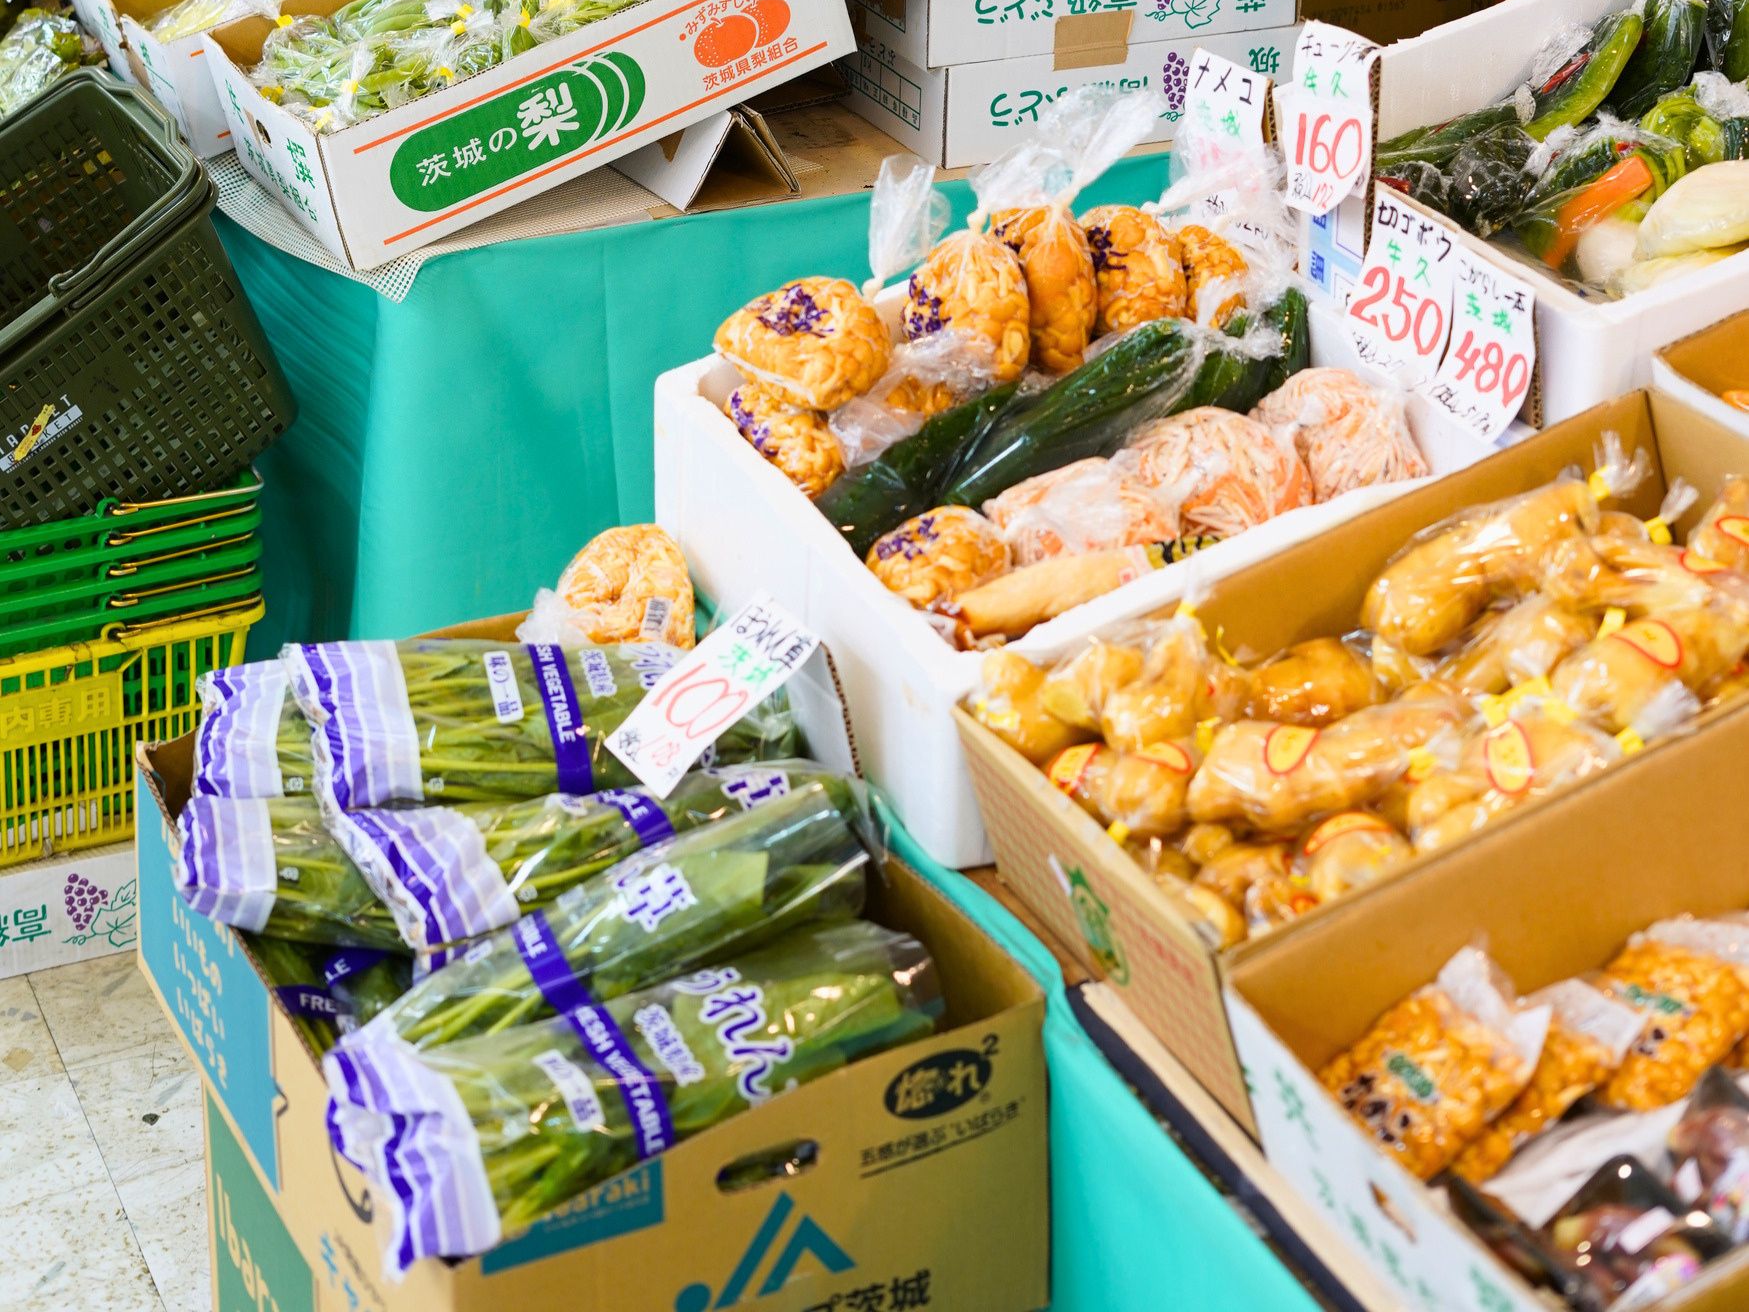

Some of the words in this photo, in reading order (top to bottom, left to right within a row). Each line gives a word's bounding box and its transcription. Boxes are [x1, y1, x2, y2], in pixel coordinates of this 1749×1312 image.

[702, 36, 799, 92] 茨城県梨組合
[1194, 57, 1252, 105] ナメコ
[416, 82, 580, 187] 茨城の梨
[1295, 112, 1363, 180] 160
[1350, 266, 1443, 356] 250
[1454, 330, 1528, 409] 480
[541, 663, 577, 745] VEGETABLE
[651, 661, 749, 739] 100
